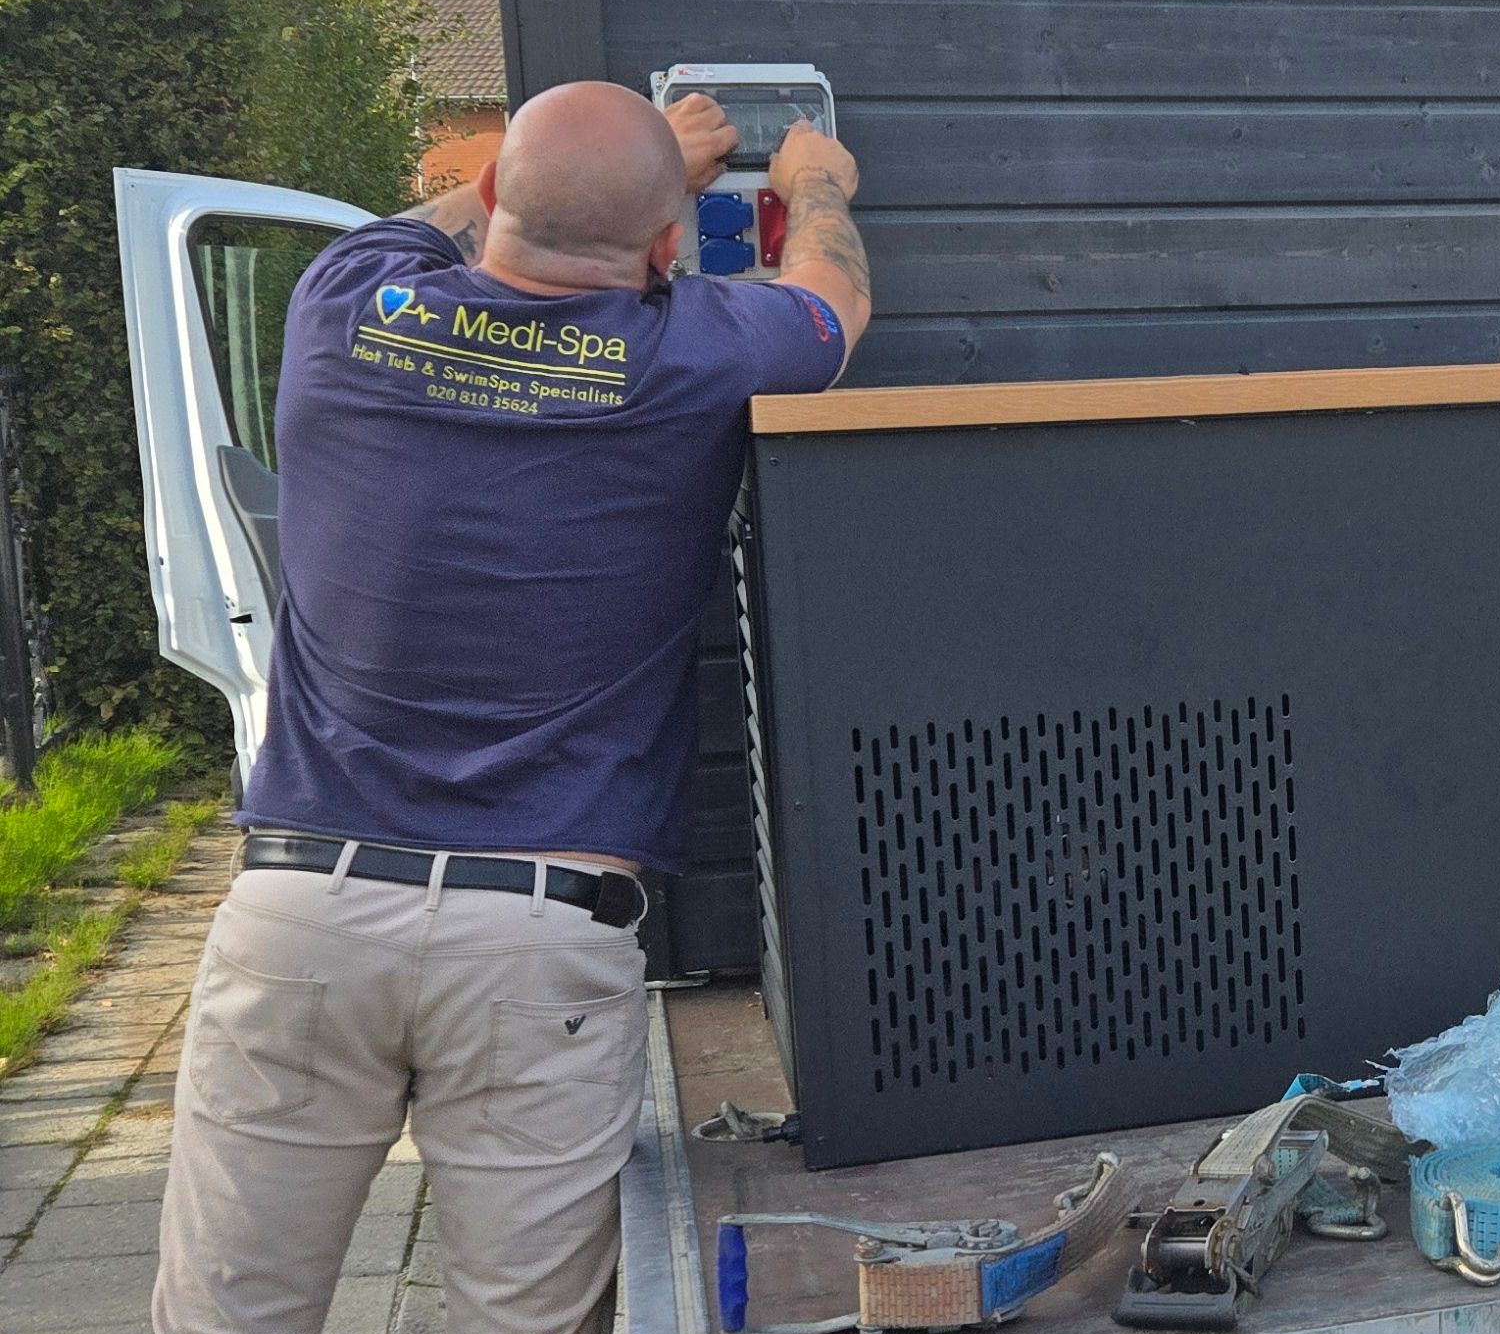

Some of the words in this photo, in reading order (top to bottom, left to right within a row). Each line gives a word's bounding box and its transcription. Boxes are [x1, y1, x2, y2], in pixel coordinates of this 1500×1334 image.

[452, 305, 627, 365] Medi-Spa
[351, 343, 382, 364] Hot
[387, 351, 416, 372] Tub
[421, 360, 436, 377] &
[442, 365, 521, 393] SwimSpa
[529, 380, 624, 406] Specialists
[427, 384, 457, 401] 020
[491, 395, 539, 415] 35624
